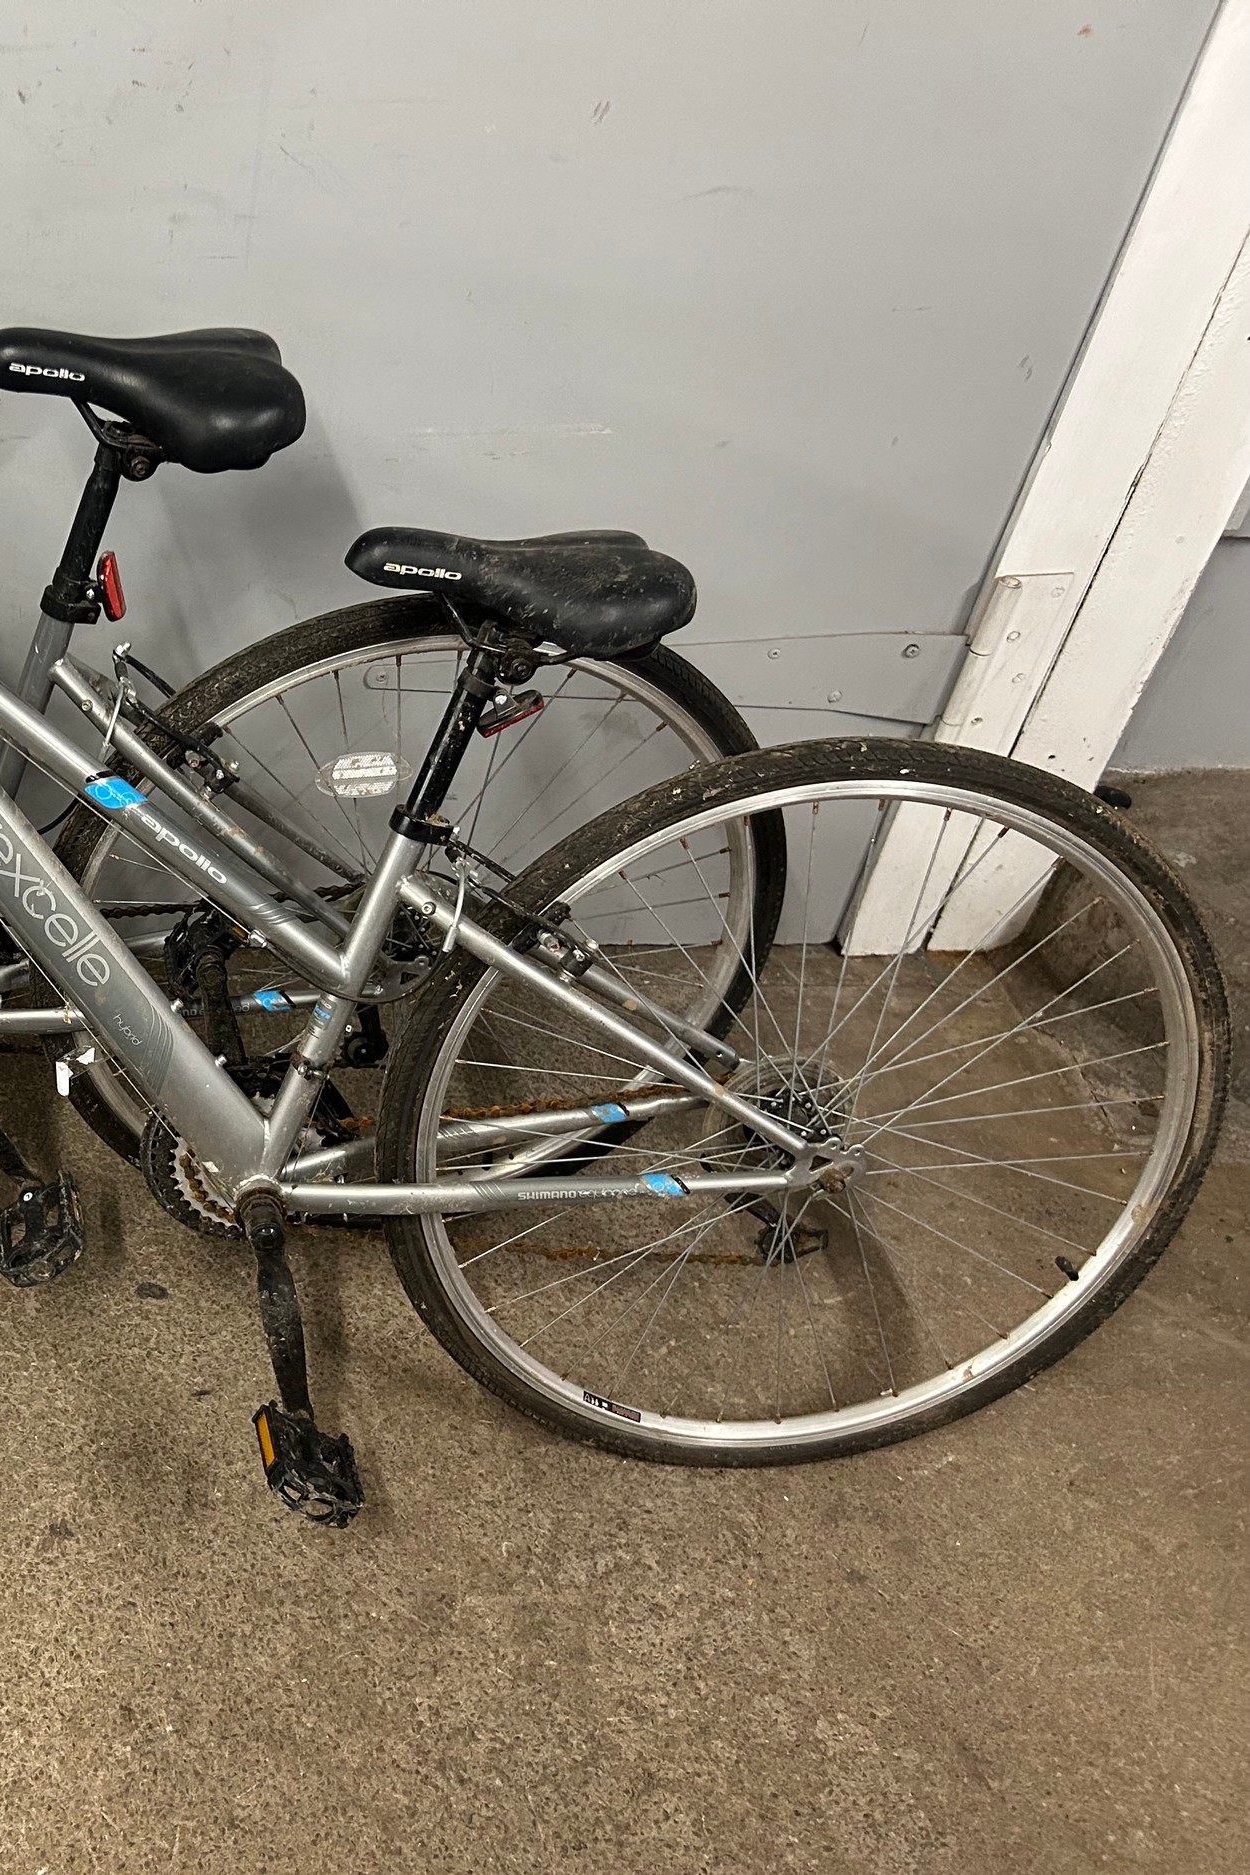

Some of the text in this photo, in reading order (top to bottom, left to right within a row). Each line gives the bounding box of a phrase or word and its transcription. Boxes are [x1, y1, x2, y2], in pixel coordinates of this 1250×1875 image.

[9, 362, 85, 382] apollo
[383, 562, 462, 581] apollo
[140, 815, 228, 884] apollo
[112, 1013, 143, 1046] hybrid
[517, 1190, 577, 1201] SHIMANO
